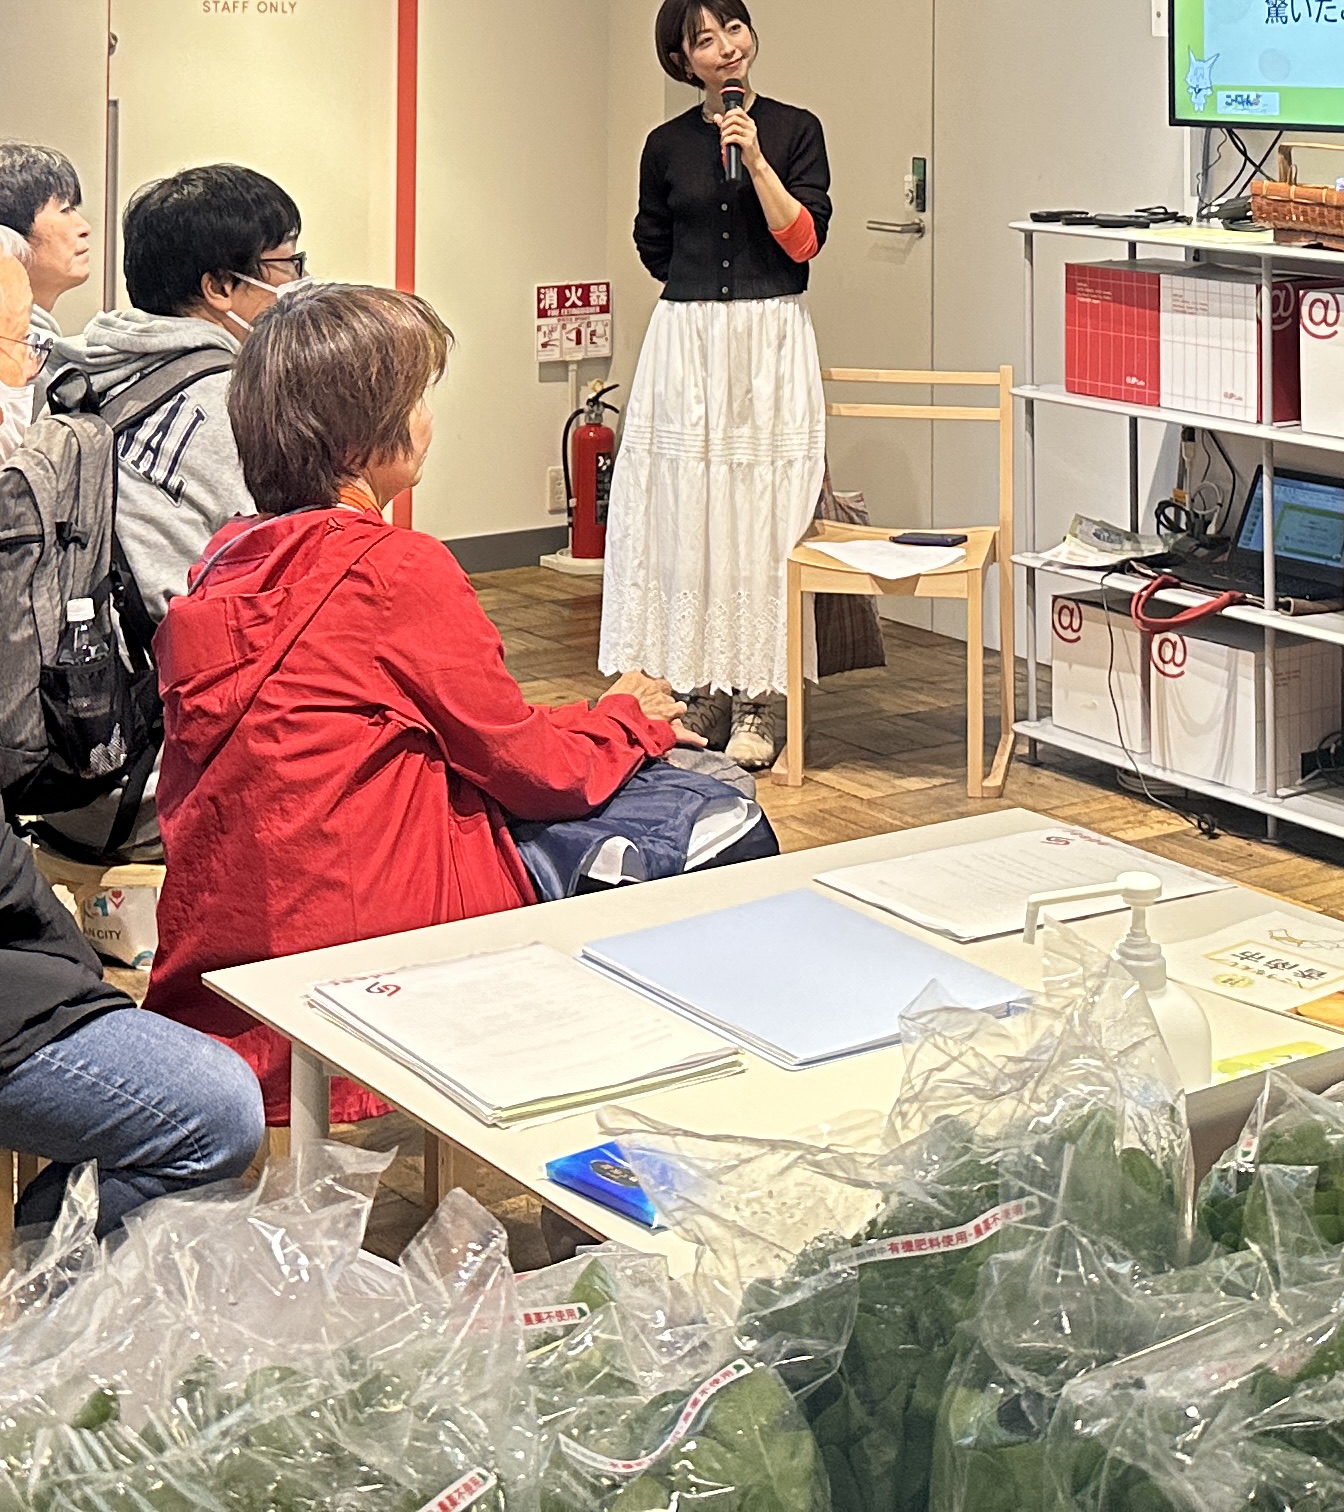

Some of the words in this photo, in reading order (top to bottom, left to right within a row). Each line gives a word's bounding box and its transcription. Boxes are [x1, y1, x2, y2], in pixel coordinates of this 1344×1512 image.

[202, 0, 250, 14] STAFF
[256, 0, 298, 14] ONLY
[539, 284, 608, 310] 消火器
[96, 929, 122, 941] CITY
